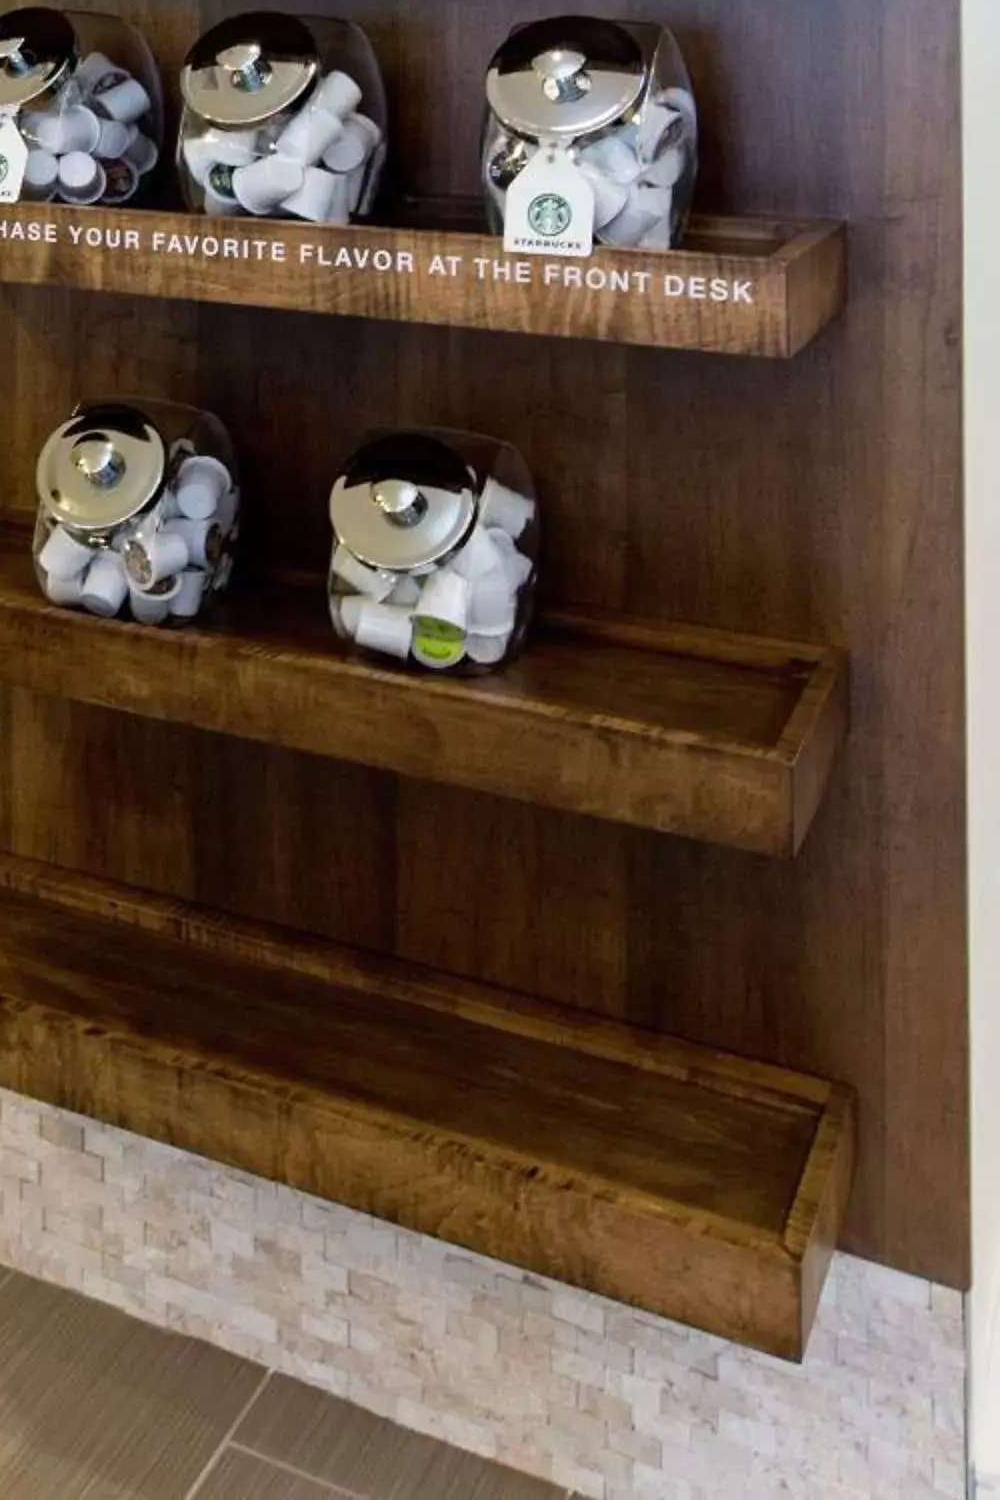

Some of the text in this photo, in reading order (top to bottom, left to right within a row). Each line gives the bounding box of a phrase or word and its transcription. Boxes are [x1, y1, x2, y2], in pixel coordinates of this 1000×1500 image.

[68, 225, 140, 250] YOUR
[152, 231, 287, 263] FAVORITE
[299, 243, 414, 273] FLAVOR
[428, 253, 463, 277] AT
[473, 257, 531, 283] THE
[544, 263, 650, 294] FRONT
[663, 274, 753, 304] DESK
